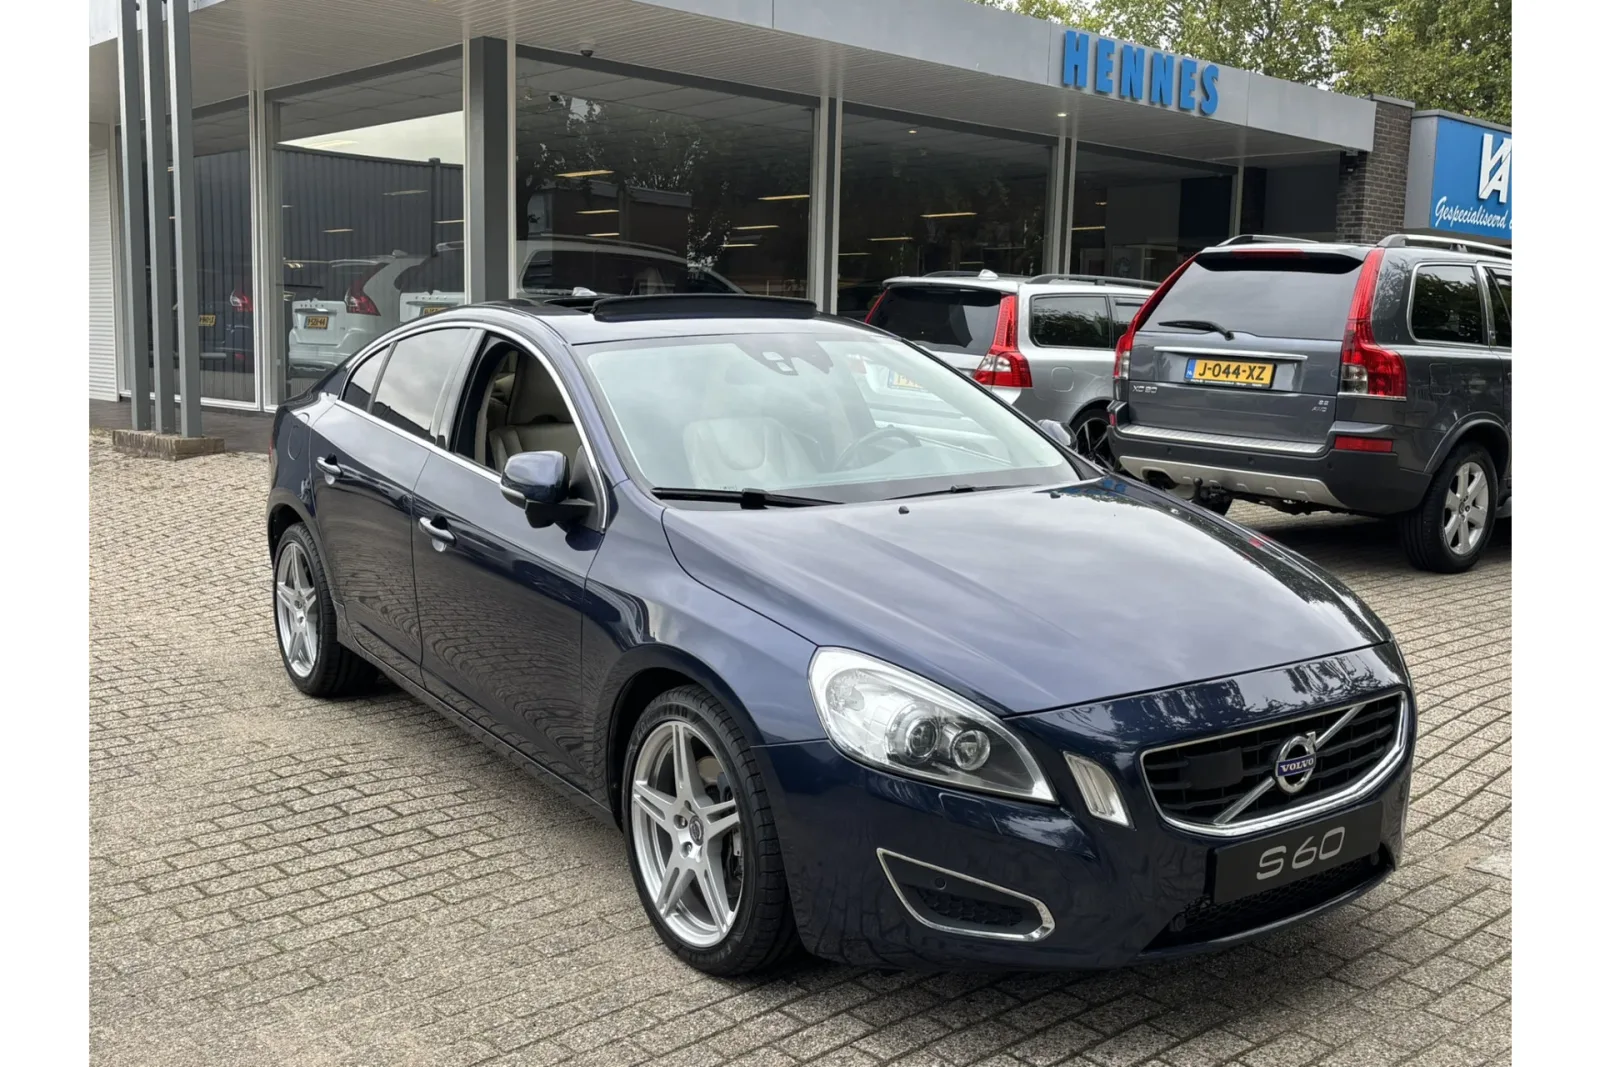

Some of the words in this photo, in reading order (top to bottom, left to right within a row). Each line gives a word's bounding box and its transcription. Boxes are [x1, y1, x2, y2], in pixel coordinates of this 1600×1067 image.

[1063, 30, 1220, 116] HENNES
[1198, 362, 1267, 381] J-044-XZ
[1280, 757, 1314, 773] VOLVO
